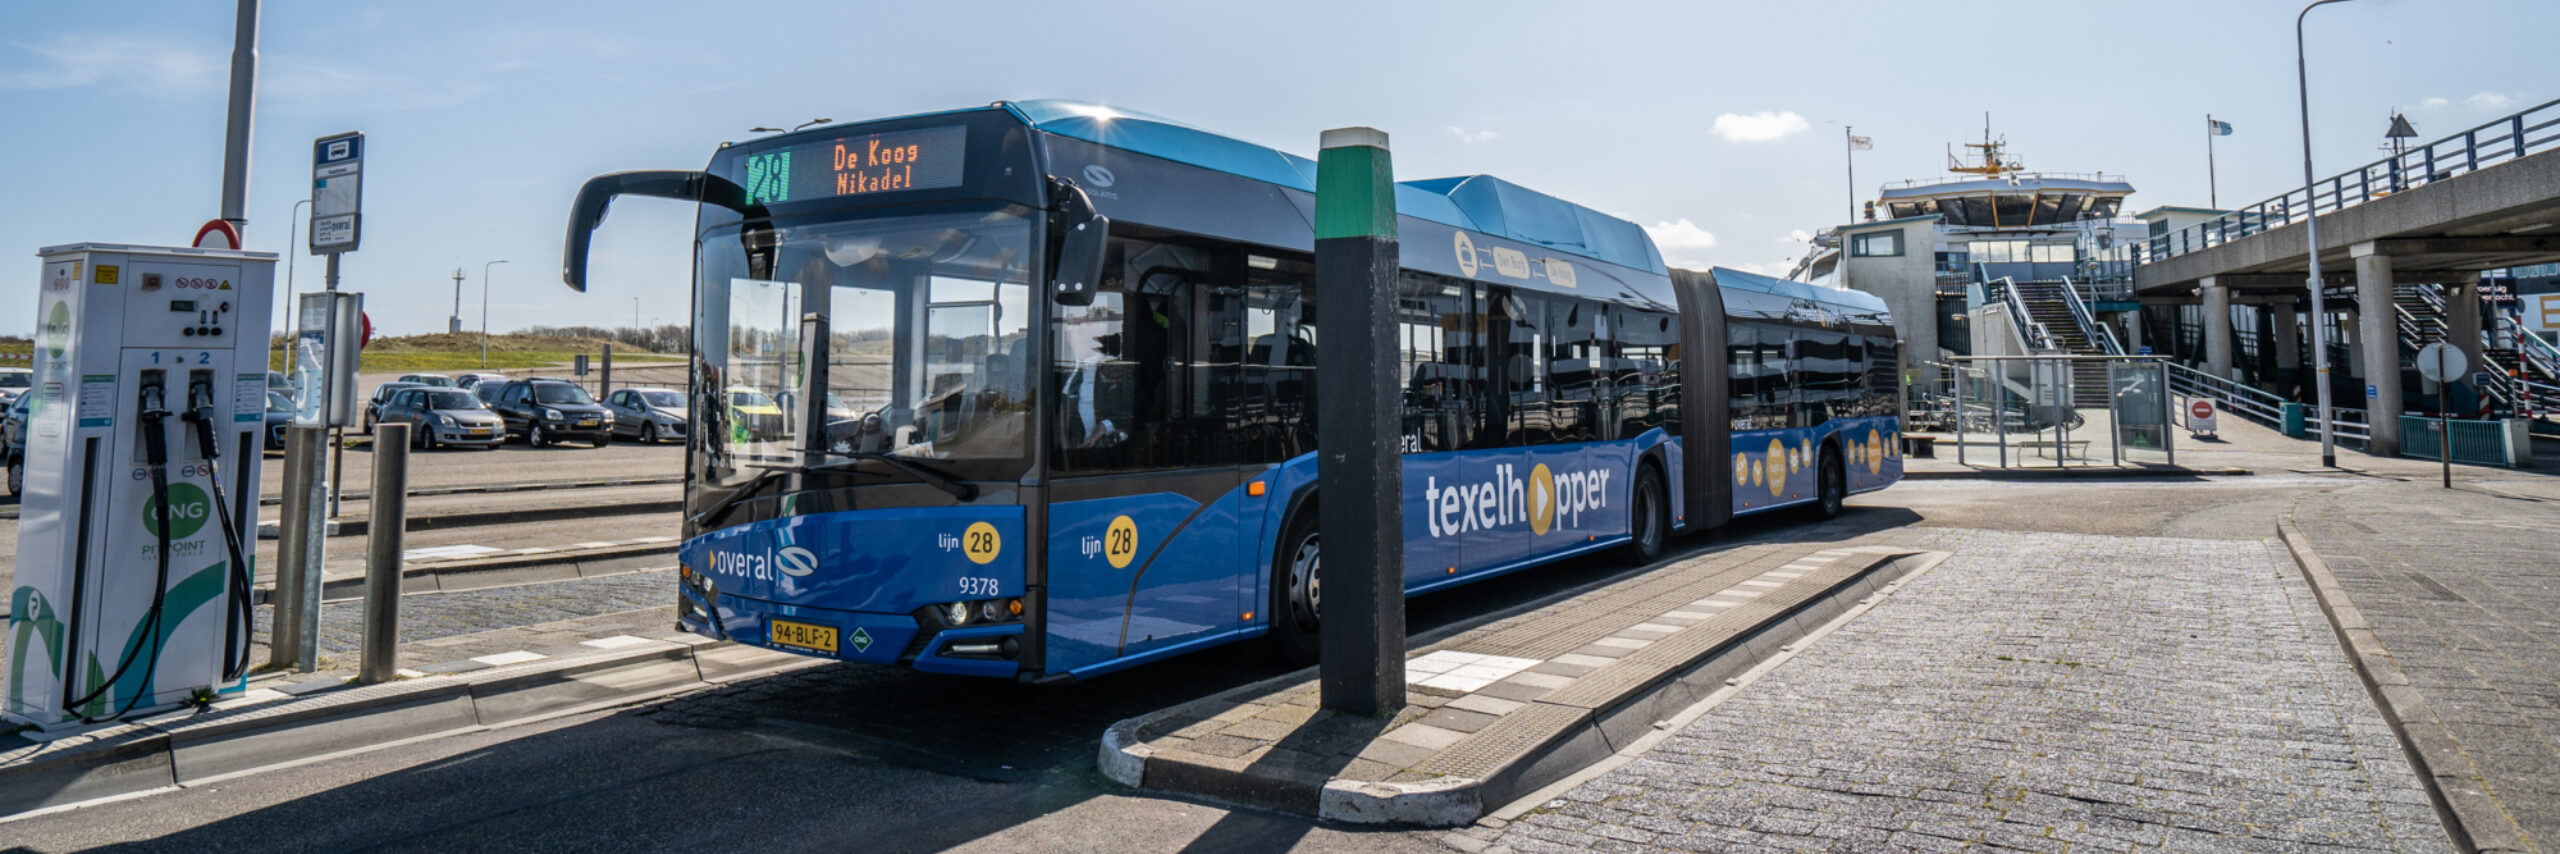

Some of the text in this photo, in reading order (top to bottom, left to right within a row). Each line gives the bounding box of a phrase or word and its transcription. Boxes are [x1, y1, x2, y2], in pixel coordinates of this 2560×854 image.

[834, 139, 918, 171] De Koog
[750, 151, 786, 204] 28
[837, 165, 912, 196] Nikadel
[151, 351, 160, 364] 1
[199, 351, 211, 364] 2
[1401, 427, 1422, 453] eral
[938, 531, 994, 554] lijn 28
[1082, 526, 1133, 556] lijn 28
[718, 546, 774, 581] overal
[959, 577, 999, 596] 9378
[776, 624, 832, 648] 94-BLF-2
[854, 635, 868, 644] CNG
